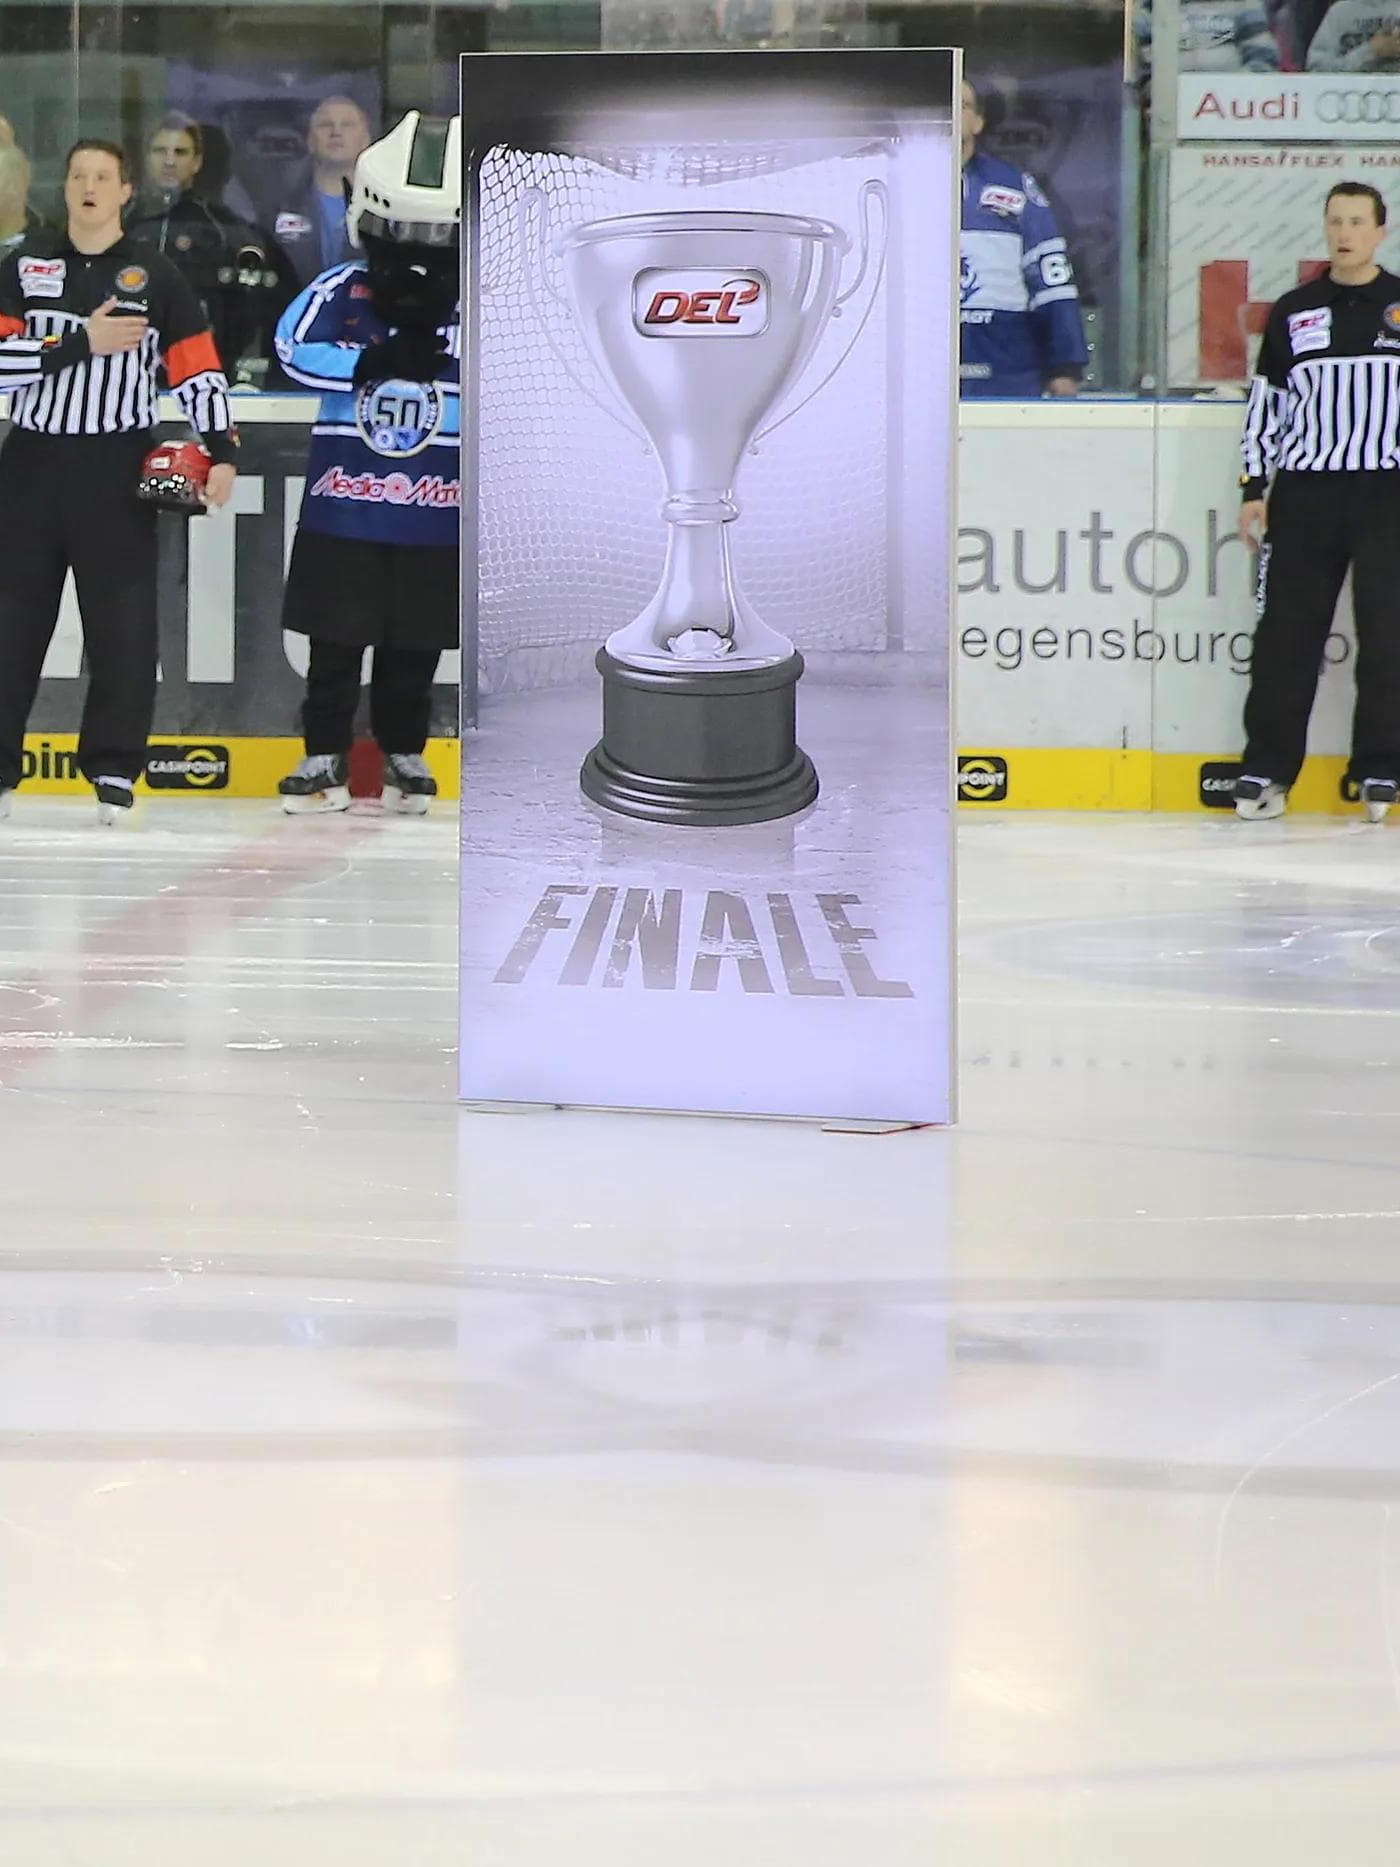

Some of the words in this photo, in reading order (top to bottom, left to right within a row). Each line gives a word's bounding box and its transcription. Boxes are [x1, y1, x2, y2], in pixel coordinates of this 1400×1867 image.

[1194, 93, 1299, 119] Audi
[376, 396, 420, 429] 50
[148, 760, 227, 774] CASHPOINT
[492, 884, 916, 998] FINALE
